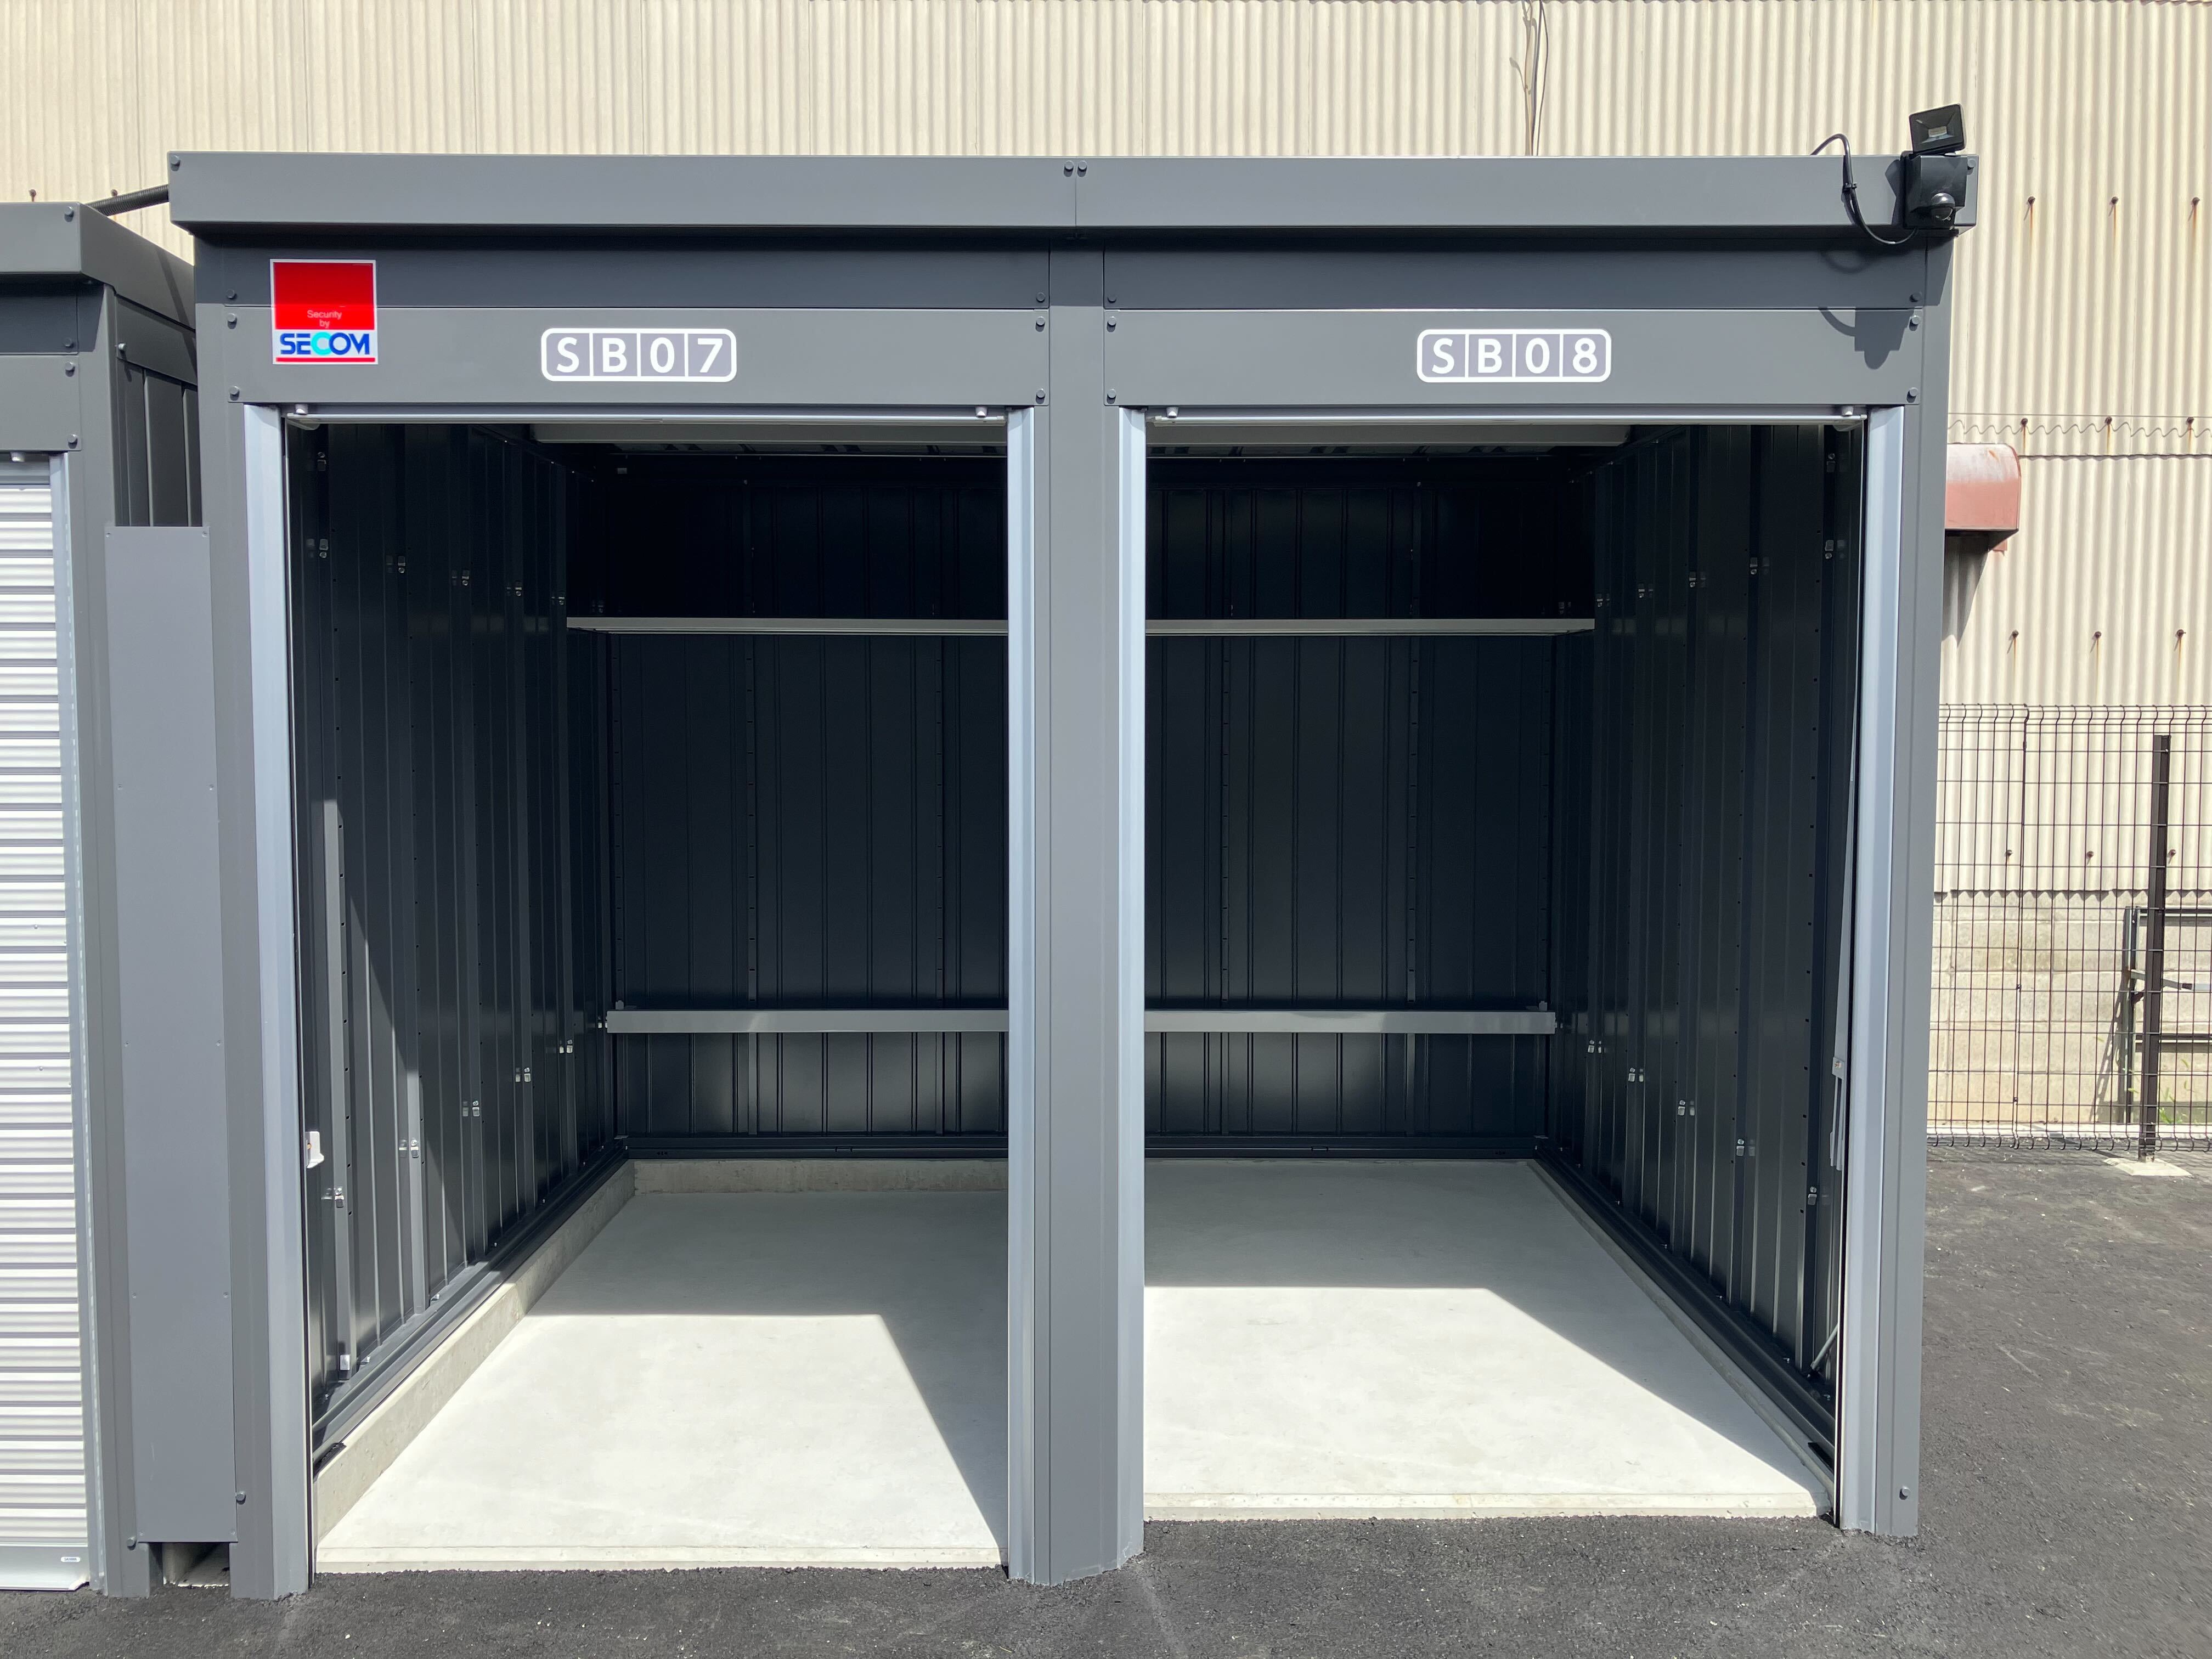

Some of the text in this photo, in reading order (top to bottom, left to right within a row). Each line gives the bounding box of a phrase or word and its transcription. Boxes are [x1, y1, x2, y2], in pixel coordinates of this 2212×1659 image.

[307, 309, 342, 320] Security
[319, 319, 330, 329] by
[280, 332, 370, 356] SECOM
[556, 337, 723, 373] SB07
[1432, 337, 1598, 374] SB08
